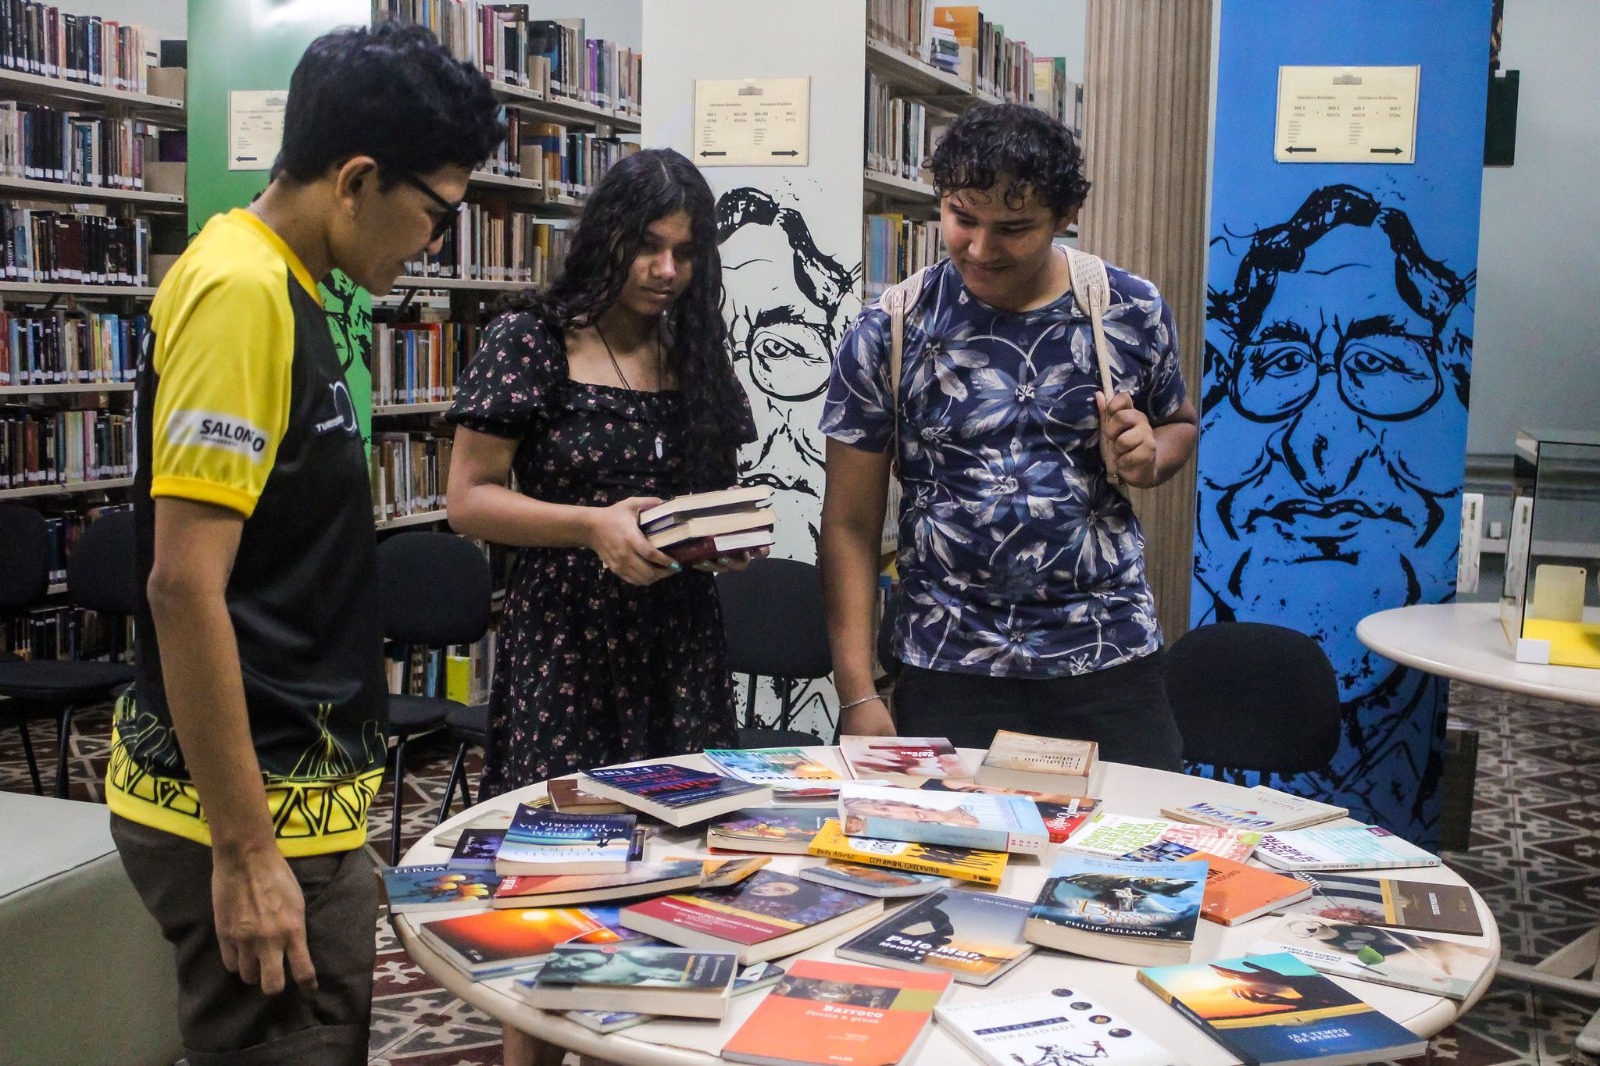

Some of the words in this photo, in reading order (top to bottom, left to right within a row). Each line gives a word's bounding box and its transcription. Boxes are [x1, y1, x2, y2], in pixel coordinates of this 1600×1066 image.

[1065, 920, 1102, 932] PHILIP
[1104, 927, 1157, 937] PULLMAN
[879, 941, 915, 952] Mente
[885, 934, 932, 950] Pelo
[934, 945, 981, 960] Mar,
[806, 1010, 838, 1019] Poesia
[823, 1005, 883, 1018] Barroco
[980, 1023, 1034, 1035] AUTOS
[983, 1024, 1078, 1043] MORALIDADE
[1310, 1028, 1346, 1036] TEMPO
[1310, 1032, 1352, 1041] PENSAR
